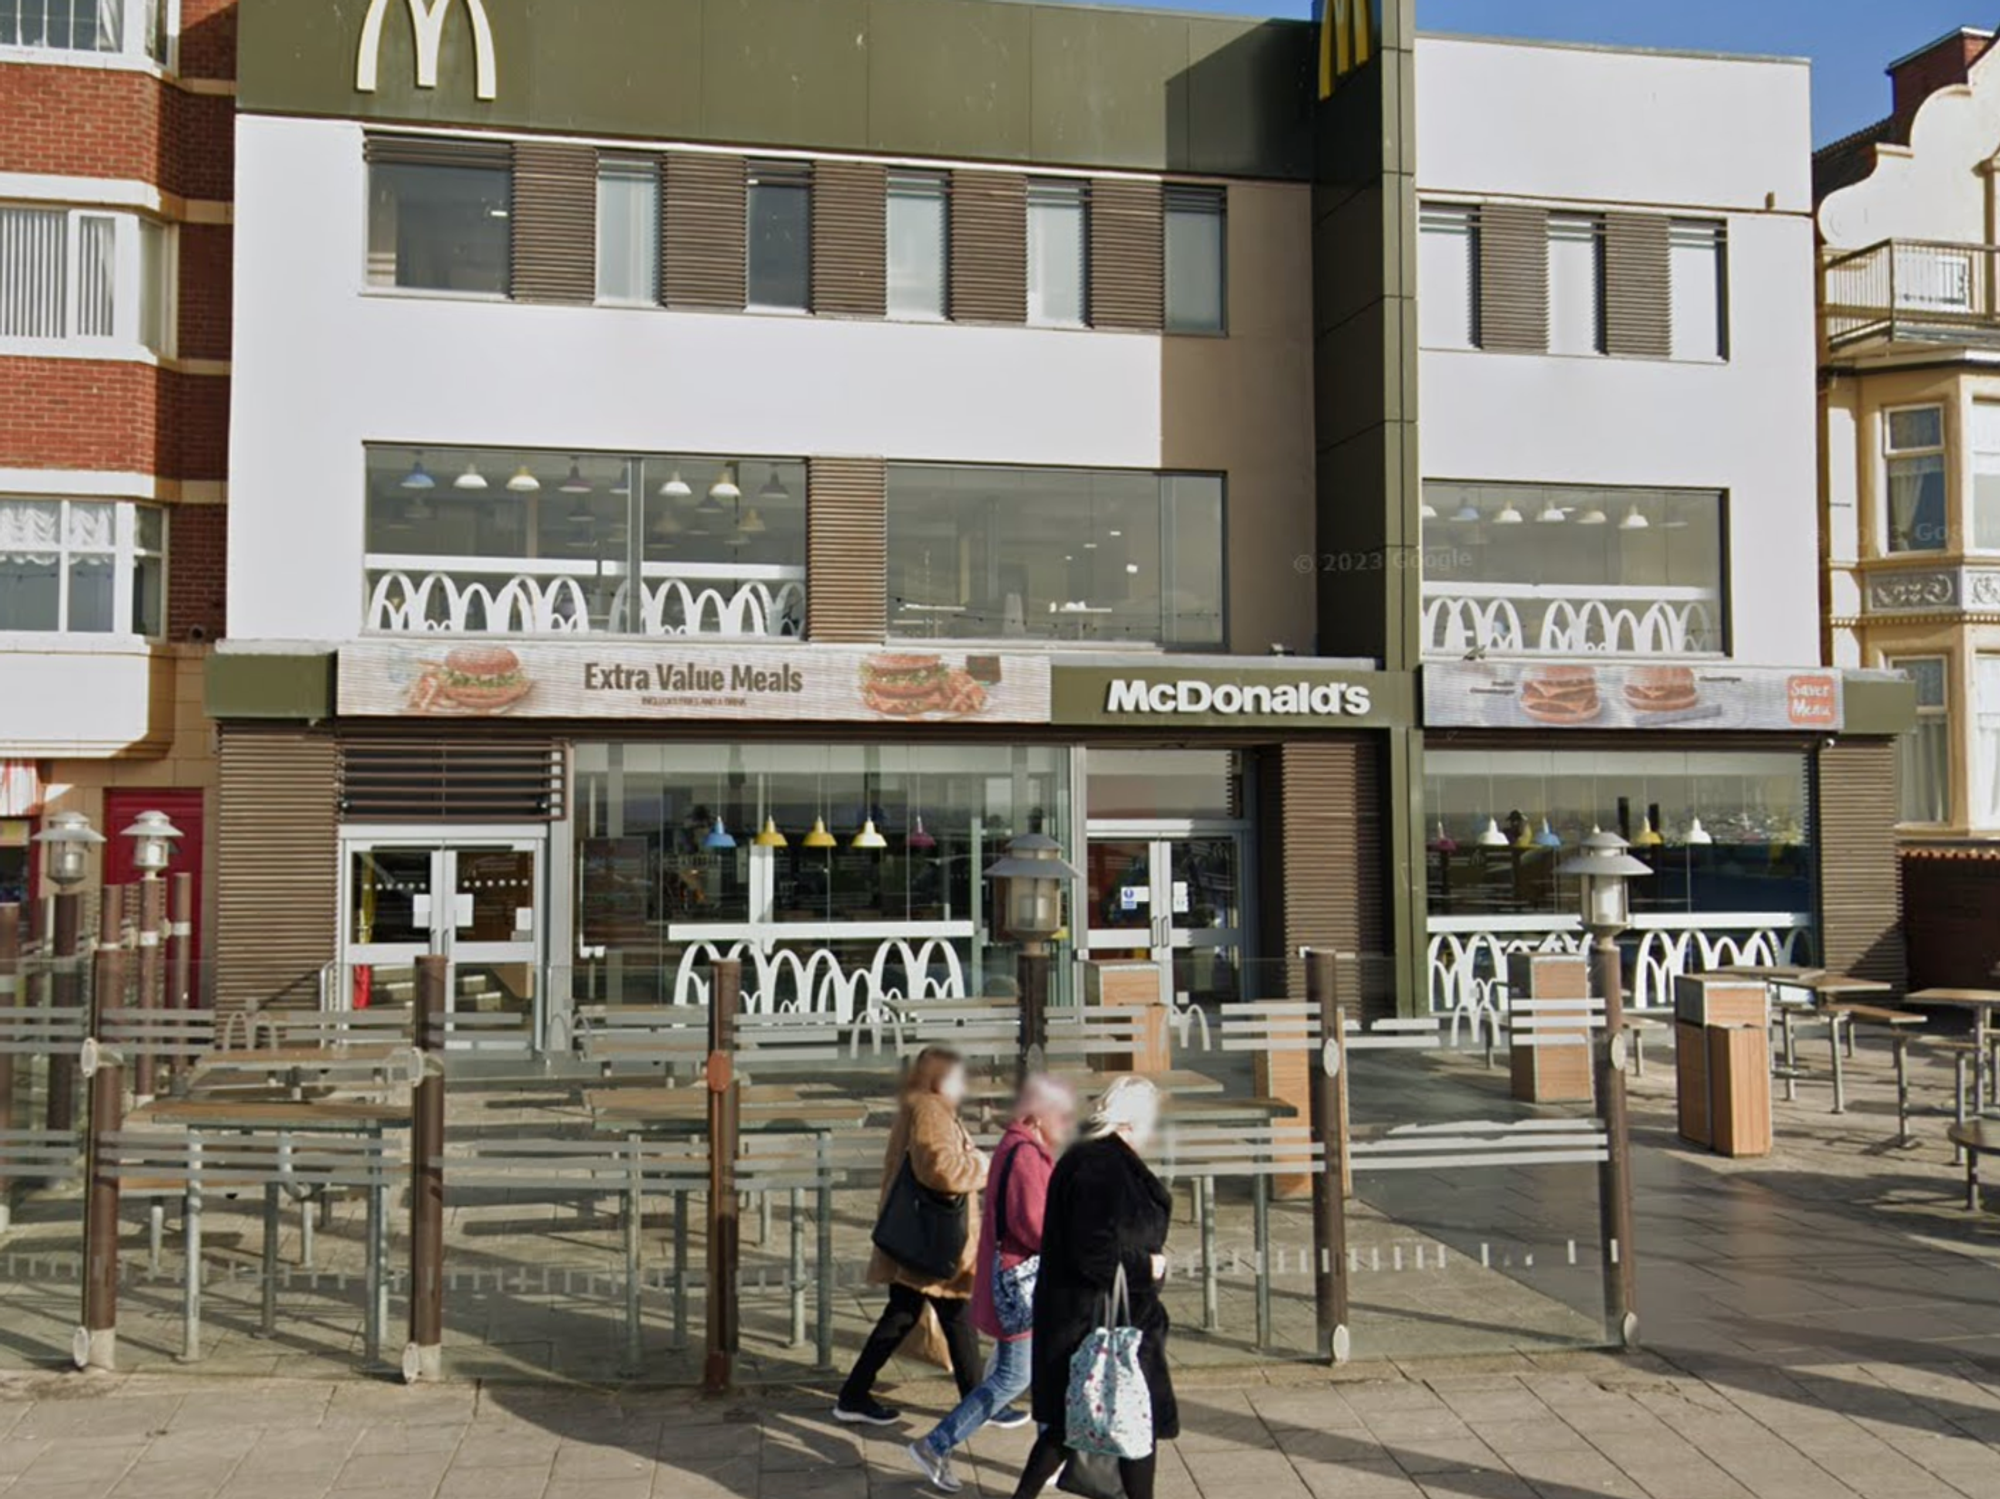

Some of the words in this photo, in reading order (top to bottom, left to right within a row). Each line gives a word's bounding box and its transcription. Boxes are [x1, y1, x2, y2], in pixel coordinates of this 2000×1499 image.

[584, 662, 650, 690] Extra
[655, 662, 725, 691] Value
[731, 663, 804, 692] Meals
[1790, 679, 1831, 697] Saver
[1107, 679, 1371, 715] McDonald's
[1791, 698, 1832, 717] Menu
